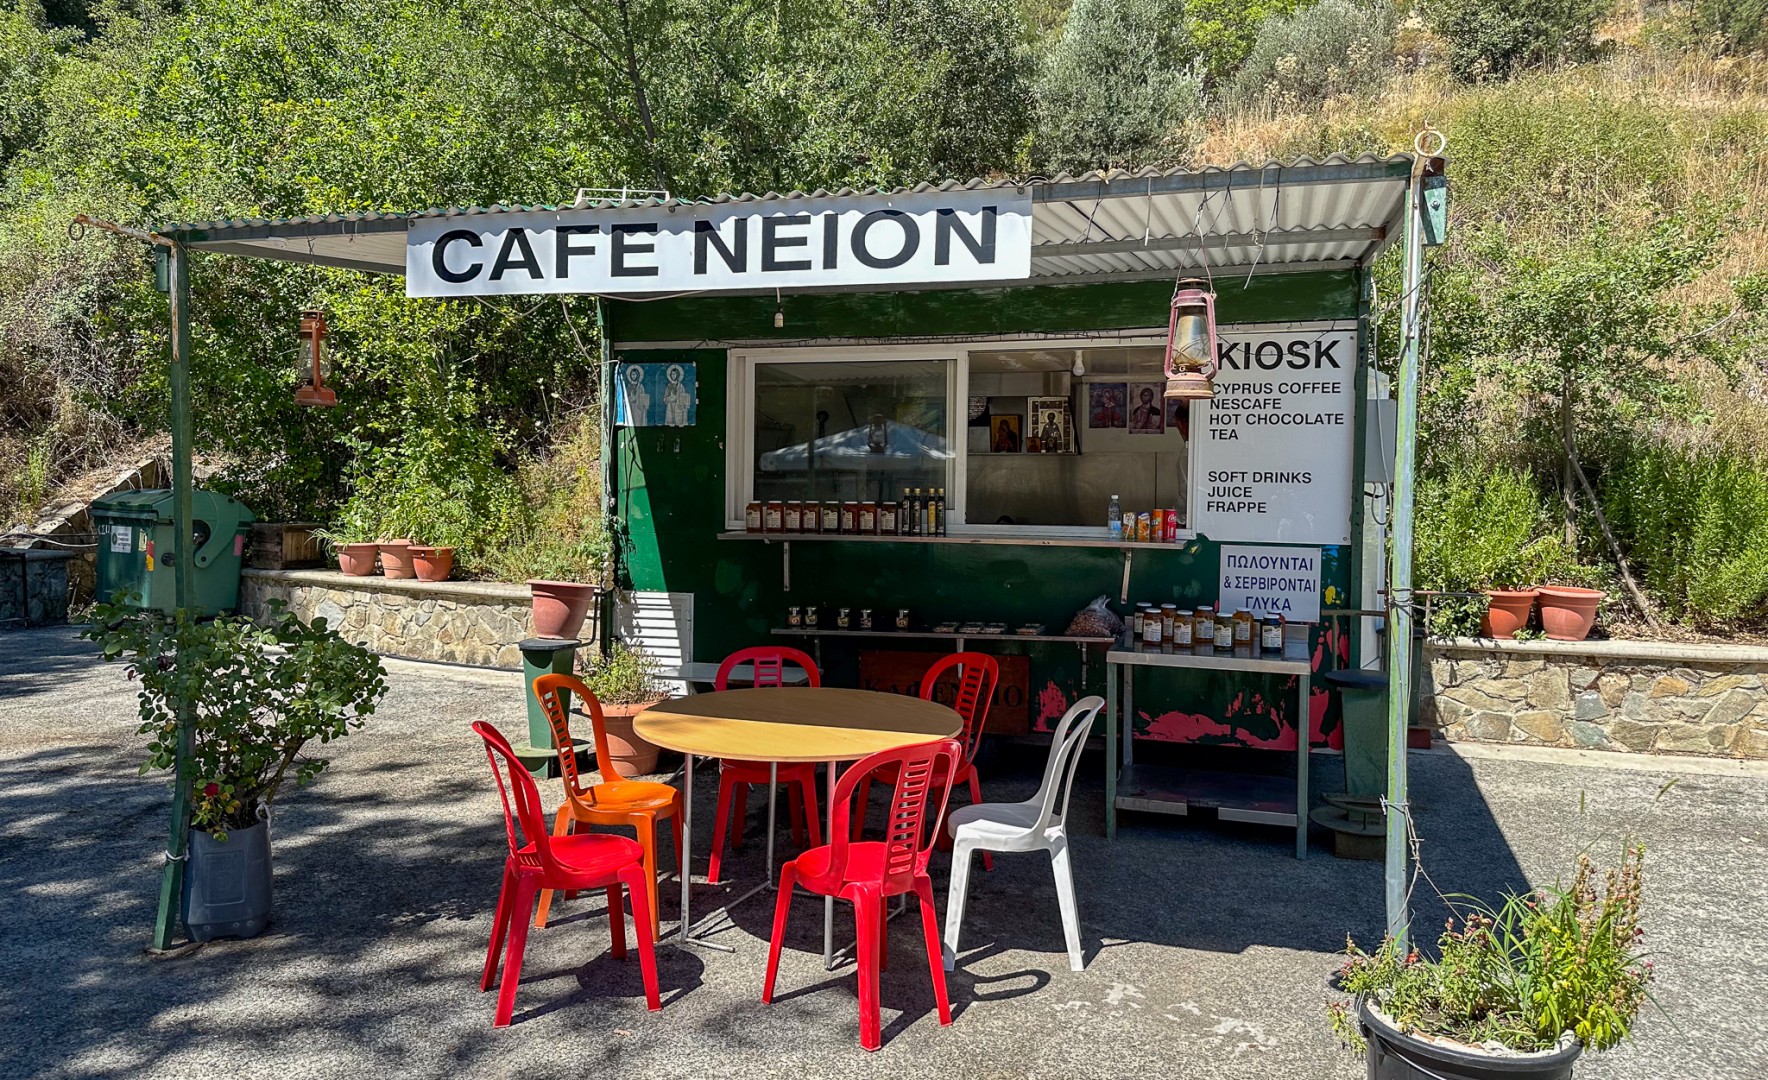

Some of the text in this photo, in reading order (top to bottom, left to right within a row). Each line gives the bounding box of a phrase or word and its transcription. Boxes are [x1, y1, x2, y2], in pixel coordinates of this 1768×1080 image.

[432, 205, 998, 283] CAFE NEION
[1216, 340, 1341, 370] KIOSK
[1213, 382, 1342, 395] CYPRUS COFFEE
[1209, 398, 1282, 410] NESCAFE
[1209, 413, 1344, 425] HOT CHOCOLATE
[1209, 428, 1239, 440] TEA
[1208, 471, 1312, 484] SOFT DRINKS
[1207, 486, 1252, 498] JUICE
[1206, 501, 1267, 513] FRAPPE
[1227, 555, 1313, 571] ΠΩΛΟΥΝΤΑΙ
[1223, 576, 1316, 592] & ΣΕΡΒΙΡΟΝΤΑΙ
[1245, 596, 1292, 612] ΓΛΥΚΑ
